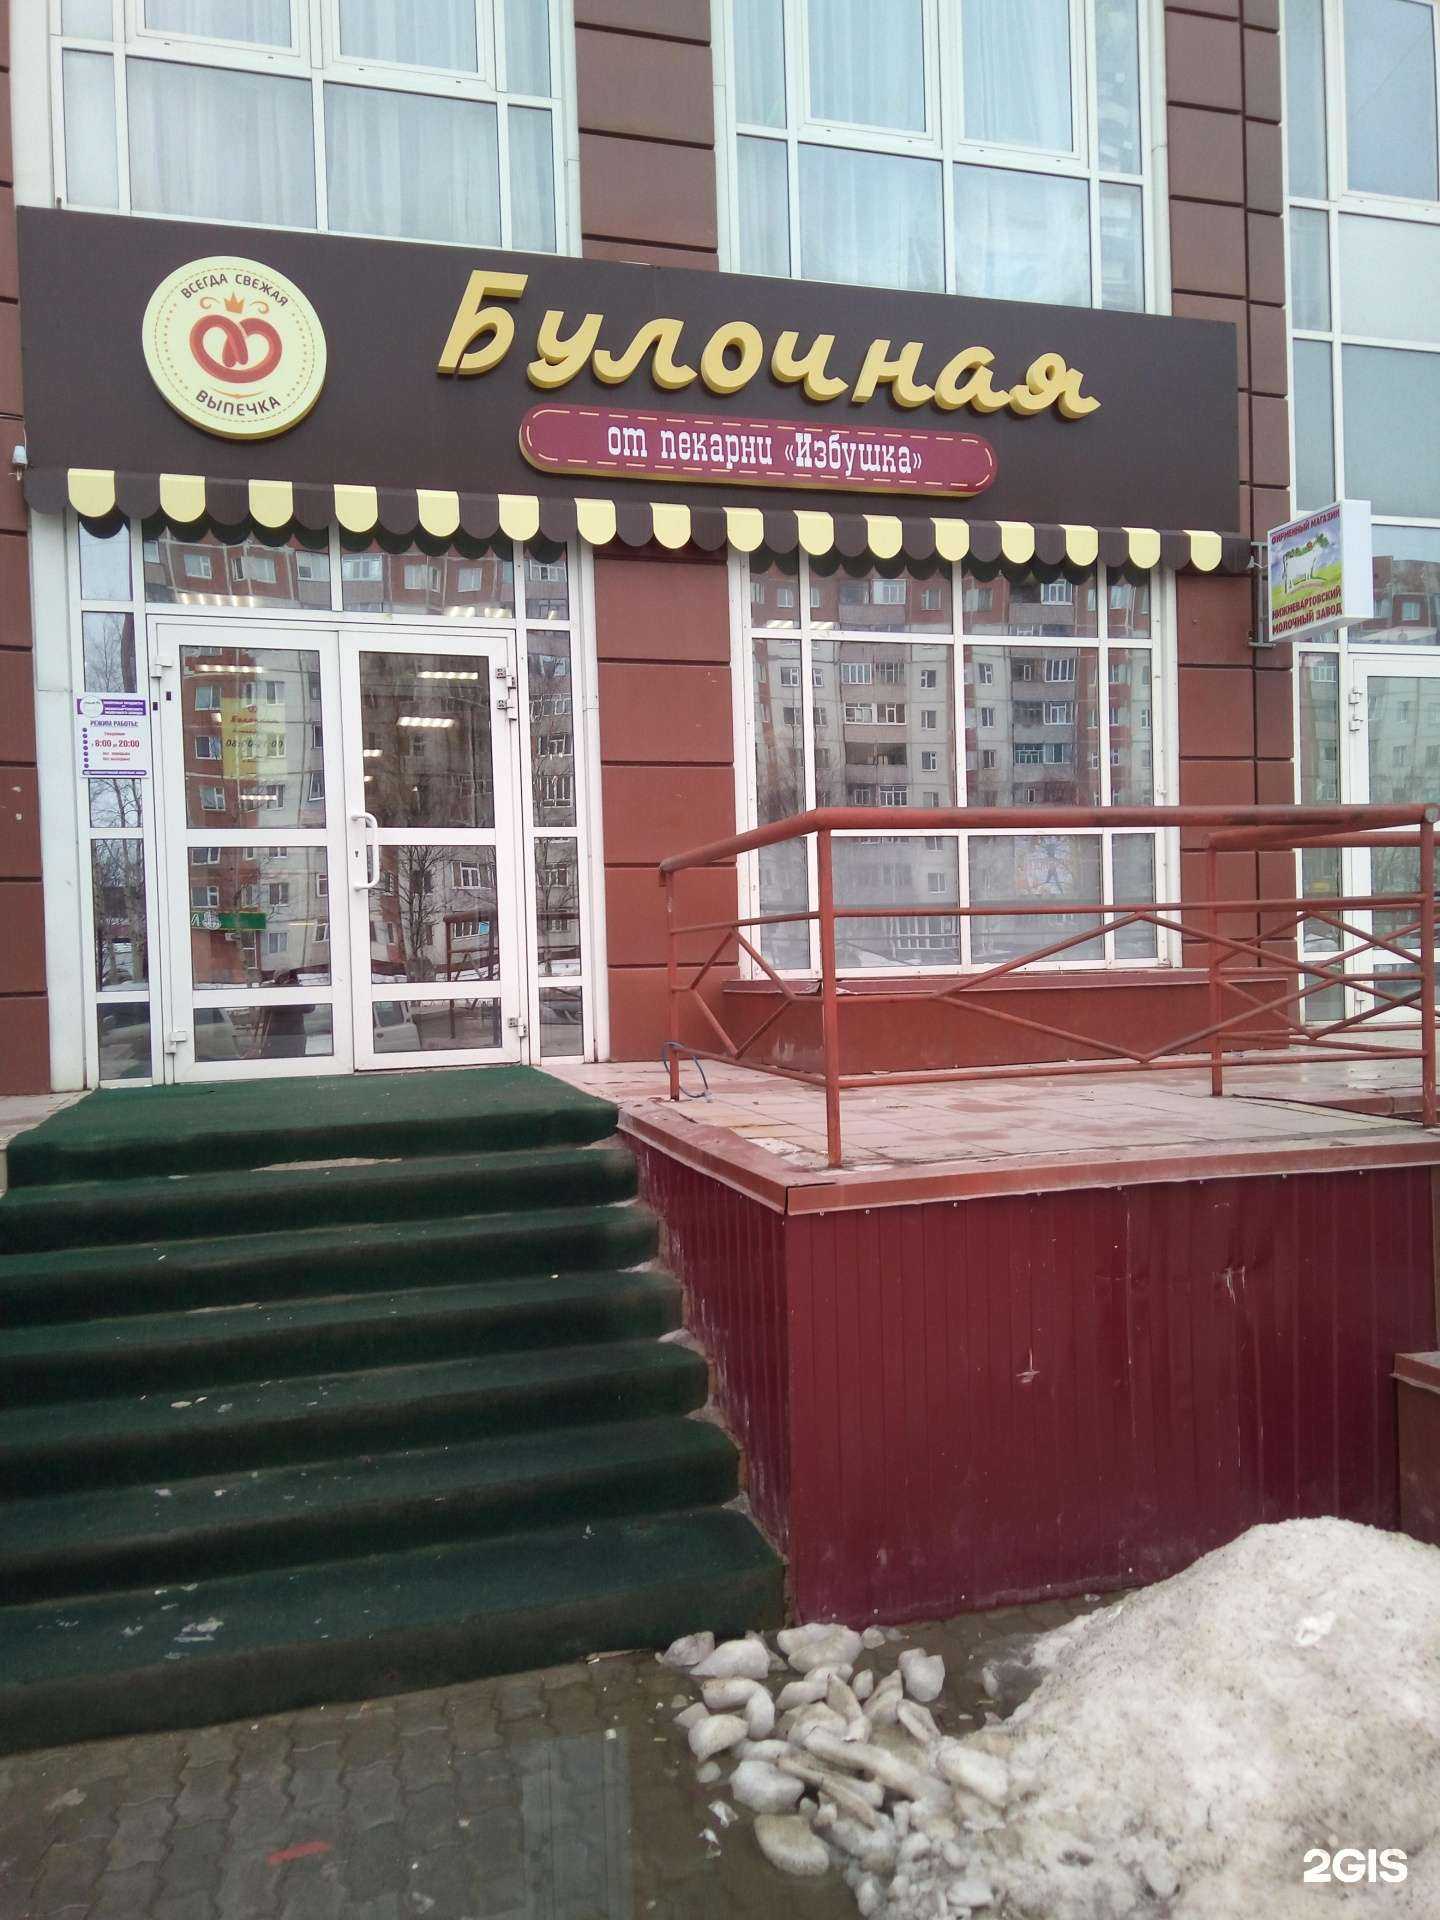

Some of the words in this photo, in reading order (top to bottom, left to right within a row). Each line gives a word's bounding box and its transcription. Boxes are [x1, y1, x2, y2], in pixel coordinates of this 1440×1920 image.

[180, 273, 229, 299] ВСЕГДА
[234, 273, 289, 307] СВЕЖАЯ
[436, 269, 1103, 420] Булочная
[196, 389, 281, 416] ВЫПЕЧКА
[607, 425, 648, 458] от
[660, 429, 772, 470] пекарни
[784, 432, 923, 476] «Избушка»
[1271, 519, 1310, 545] ФИРМЕННЫЙ
[1310, 508, 1340, 529] МАГАЗИН
[1272, 585, 1342, 620] НИЖНЕВАРТОВСКИЙ
[1272, 609, 1315, 636] МОЛОЧНЫЙ
[1316, 602, 1343, 621] ЗАВОД
[95, 739, 112, 748] 8:00
[118, 739, 140, 748] 20:00
